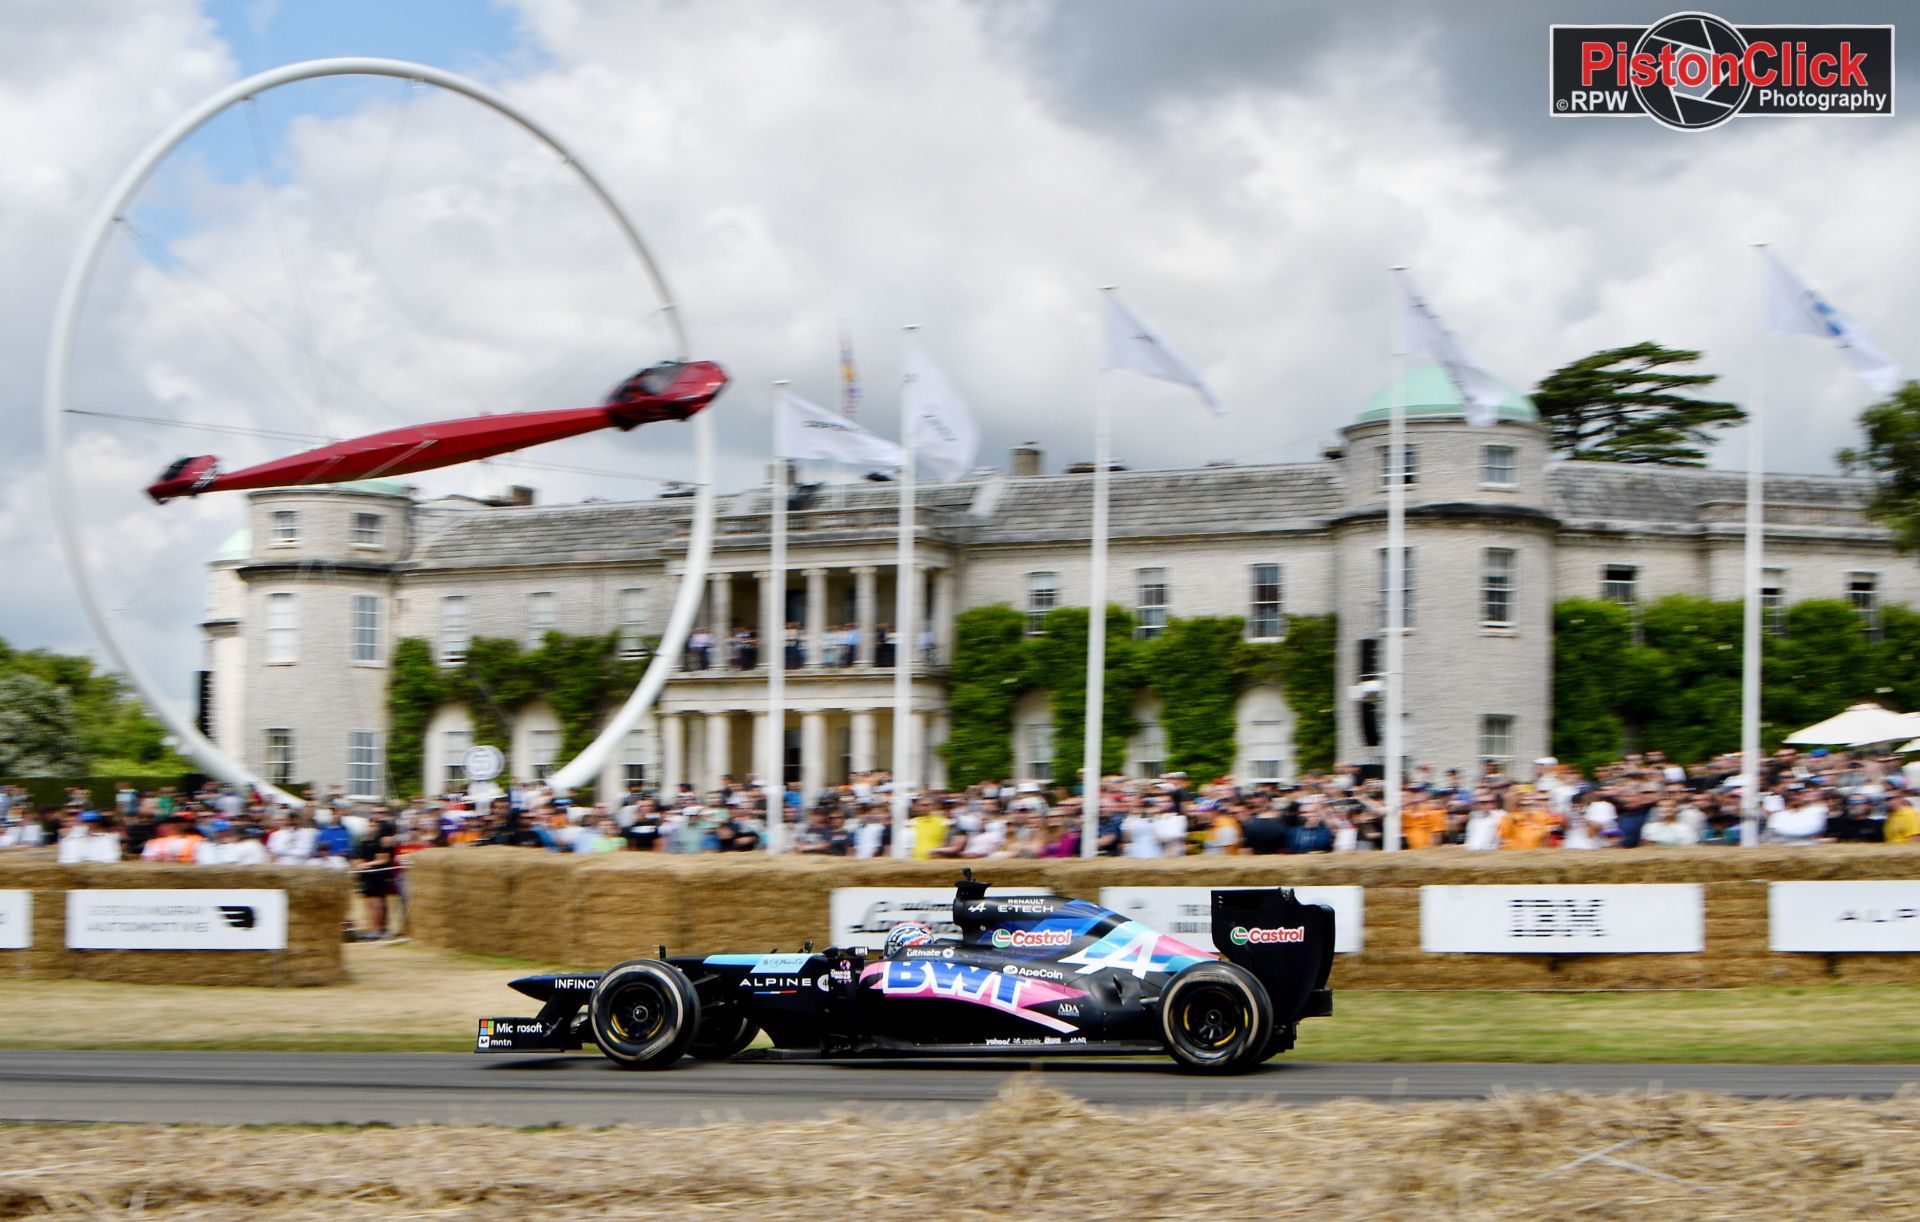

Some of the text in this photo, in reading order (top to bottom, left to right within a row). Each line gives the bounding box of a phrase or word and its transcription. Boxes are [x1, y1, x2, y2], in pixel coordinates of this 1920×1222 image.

[998, 905, 1054, 913] E-TECH
[1511, 899, 1606, 937] IBM
[1012, 930, 1071, 947] Castrol
[1249, 927, 1304, 943] Castrol
[1018, 968, 1063, 981] ApeCoin
[740, 978, 811, 987] ALPINE
[884, 961, 1030, 1011] BWT
[1058, 1003, 1080, 1013] ADA
[490, 1038, 512, 1047] mntn
